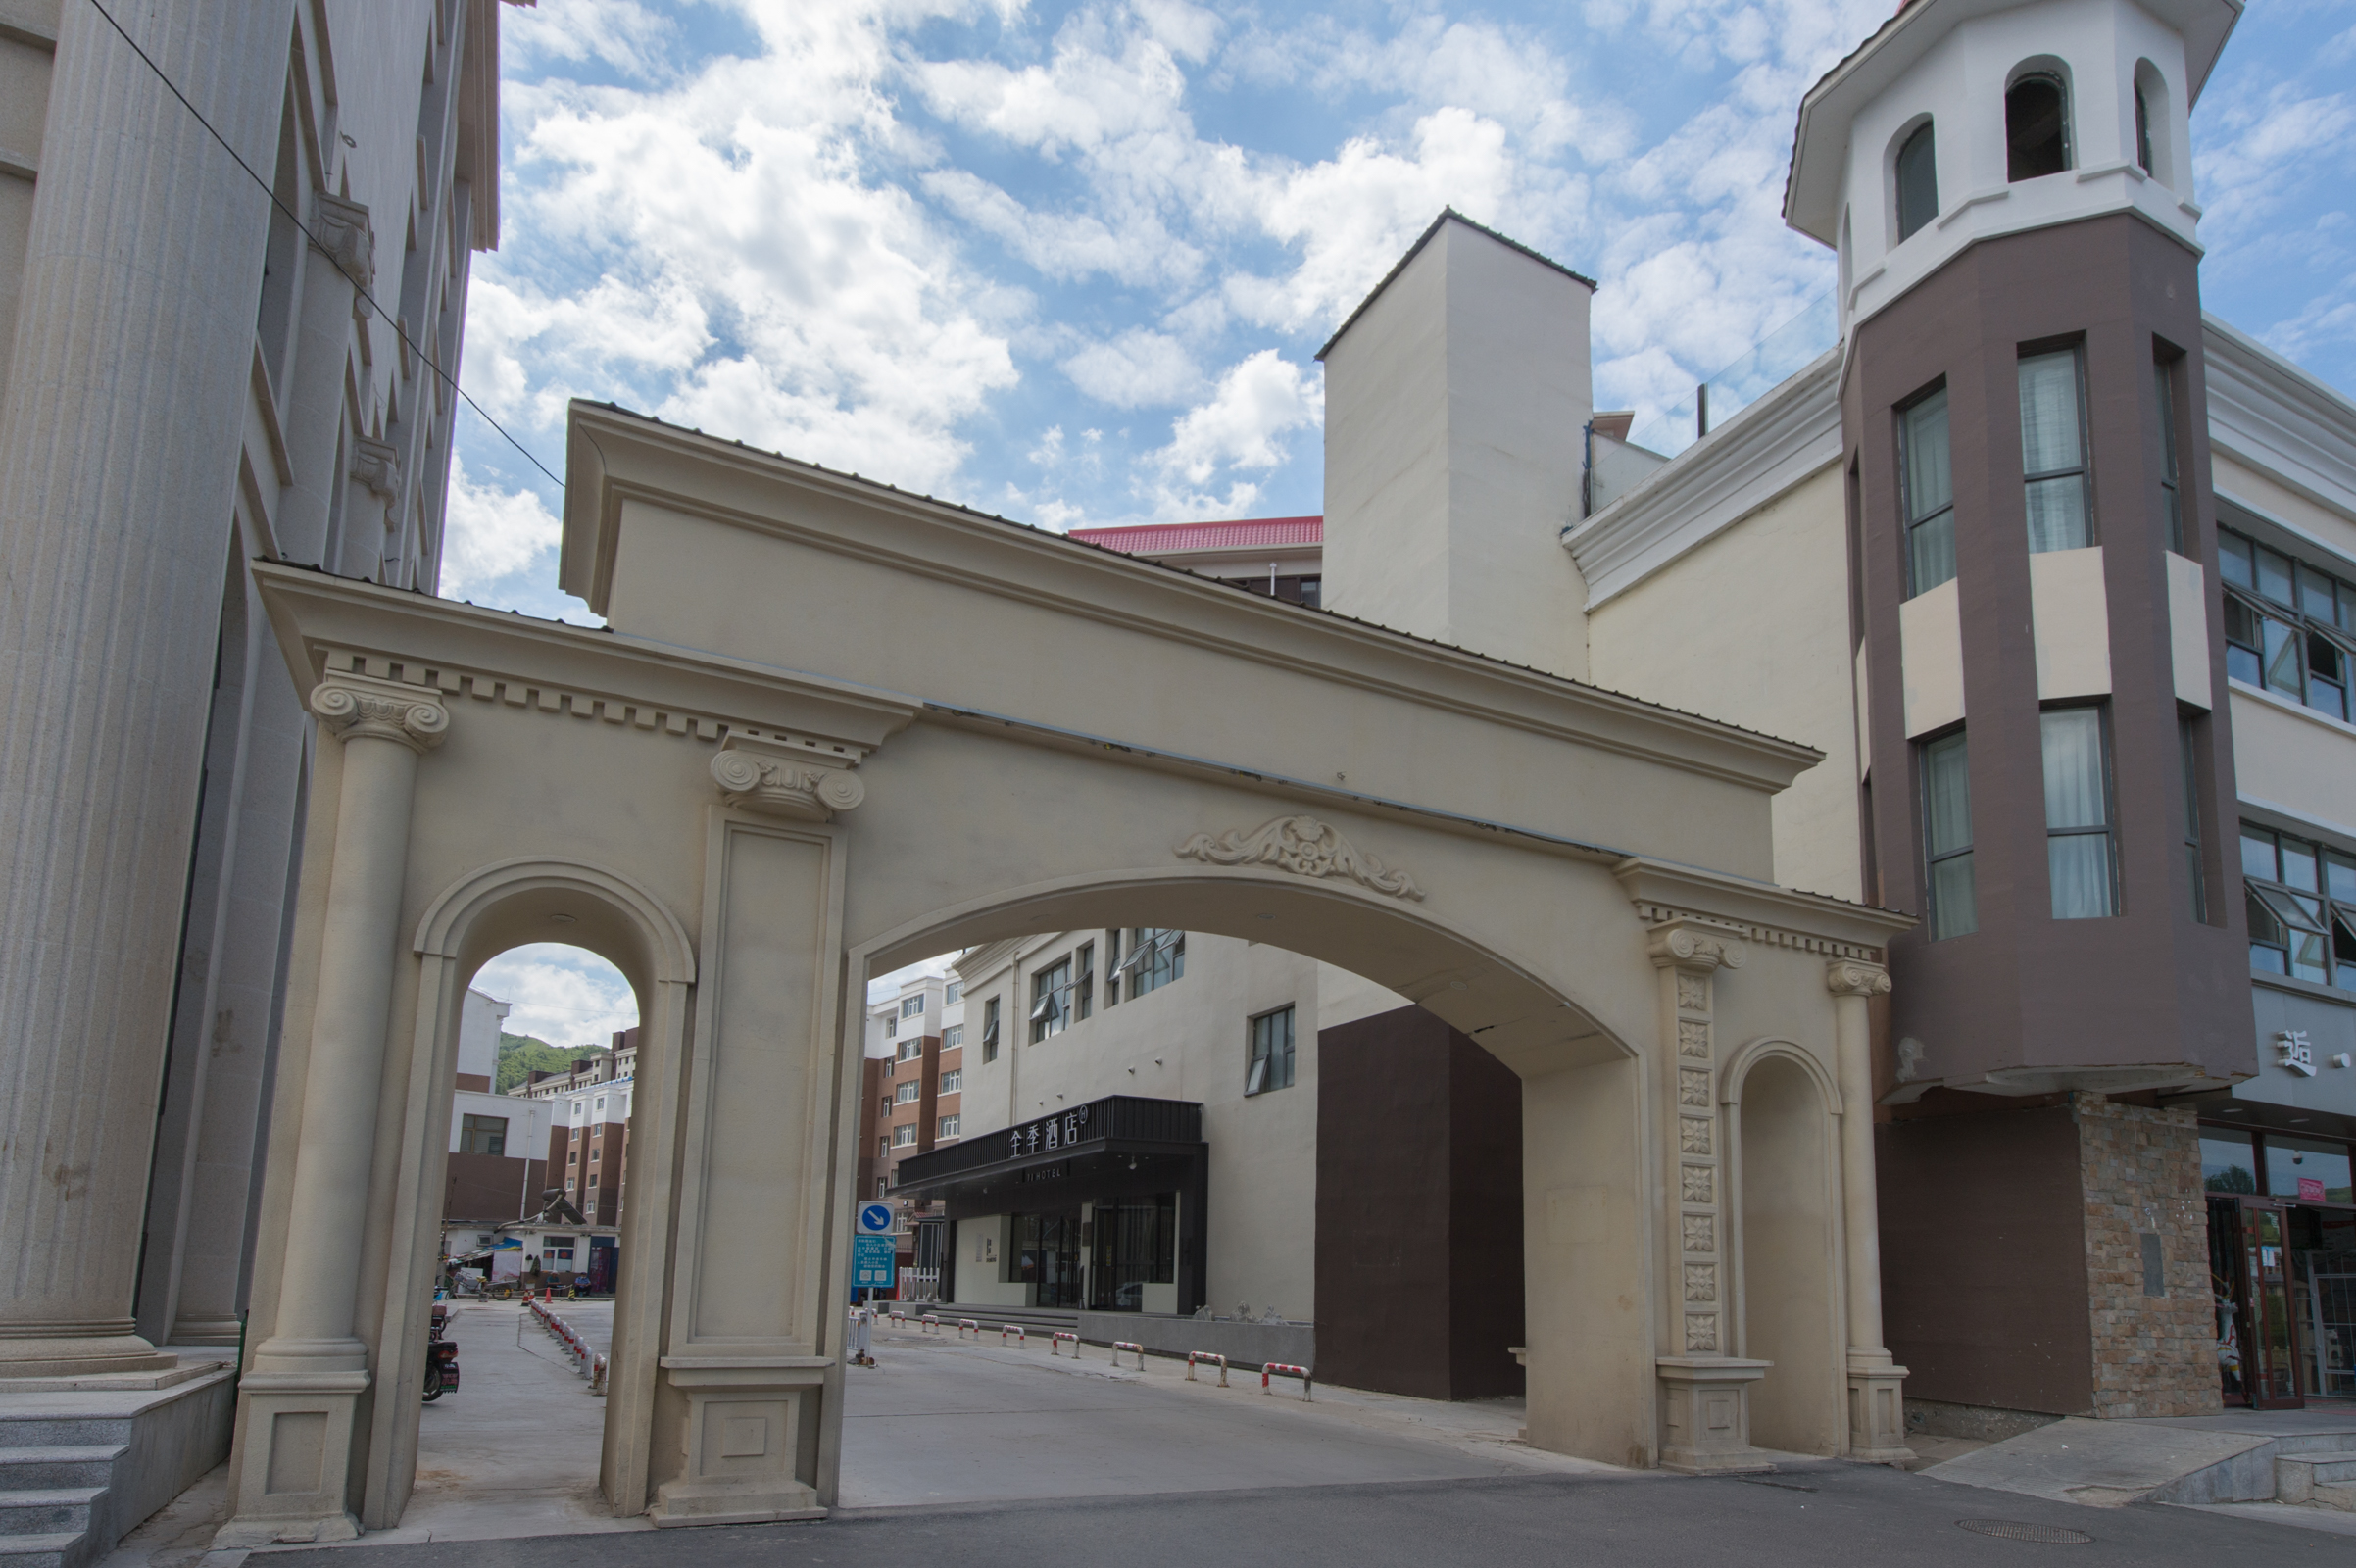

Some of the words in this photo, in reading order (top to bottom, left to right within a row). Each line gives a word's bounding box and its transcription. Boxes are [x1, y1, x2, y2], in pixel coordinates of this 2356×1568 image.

[1010, 1112, 1077, 1158] 全季酒店
[1036, 1168, 1061, 1181] HOTEL
